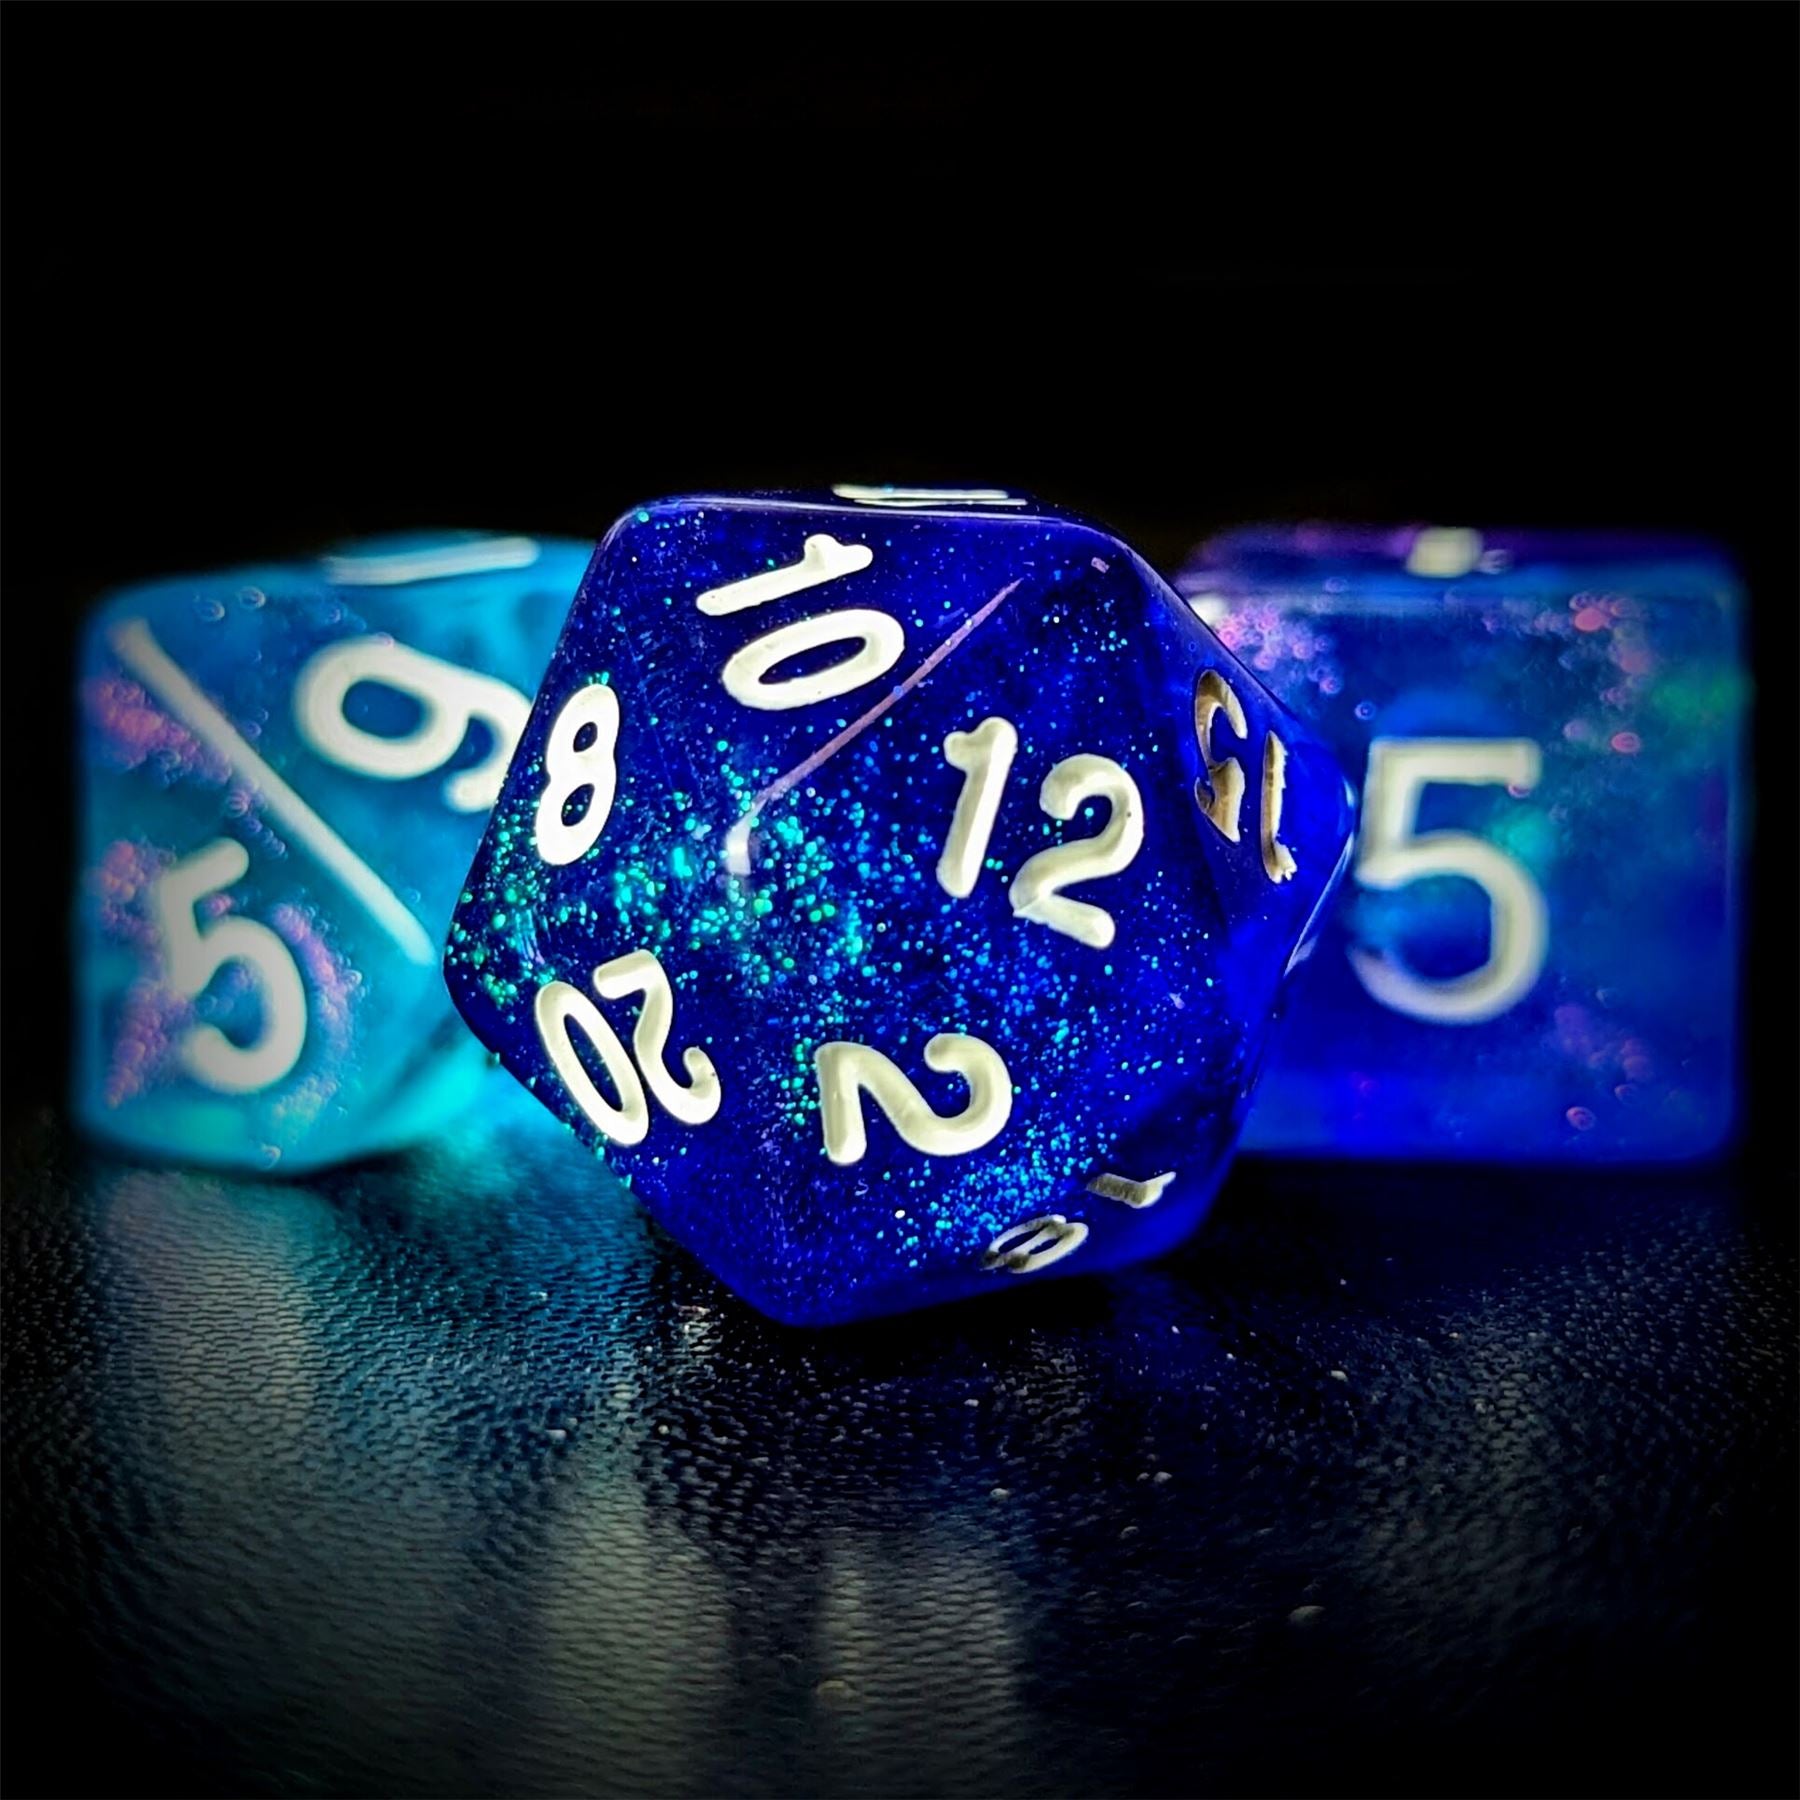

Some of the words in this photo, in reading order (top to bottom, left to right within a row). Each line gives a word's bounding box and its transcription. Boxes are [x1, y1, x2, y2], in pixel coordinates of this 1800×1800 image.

[698, 534, 905, 710] 10
[535, 683, 621, 865] 8
[936, 717, 1144, 948] 12
[155, 836, 306, 1093] 5
[1354, 738, 1548, 1022] 5
[534, 949, 722, 1146] 20
[815, 1033, 1012, 1166] 2
